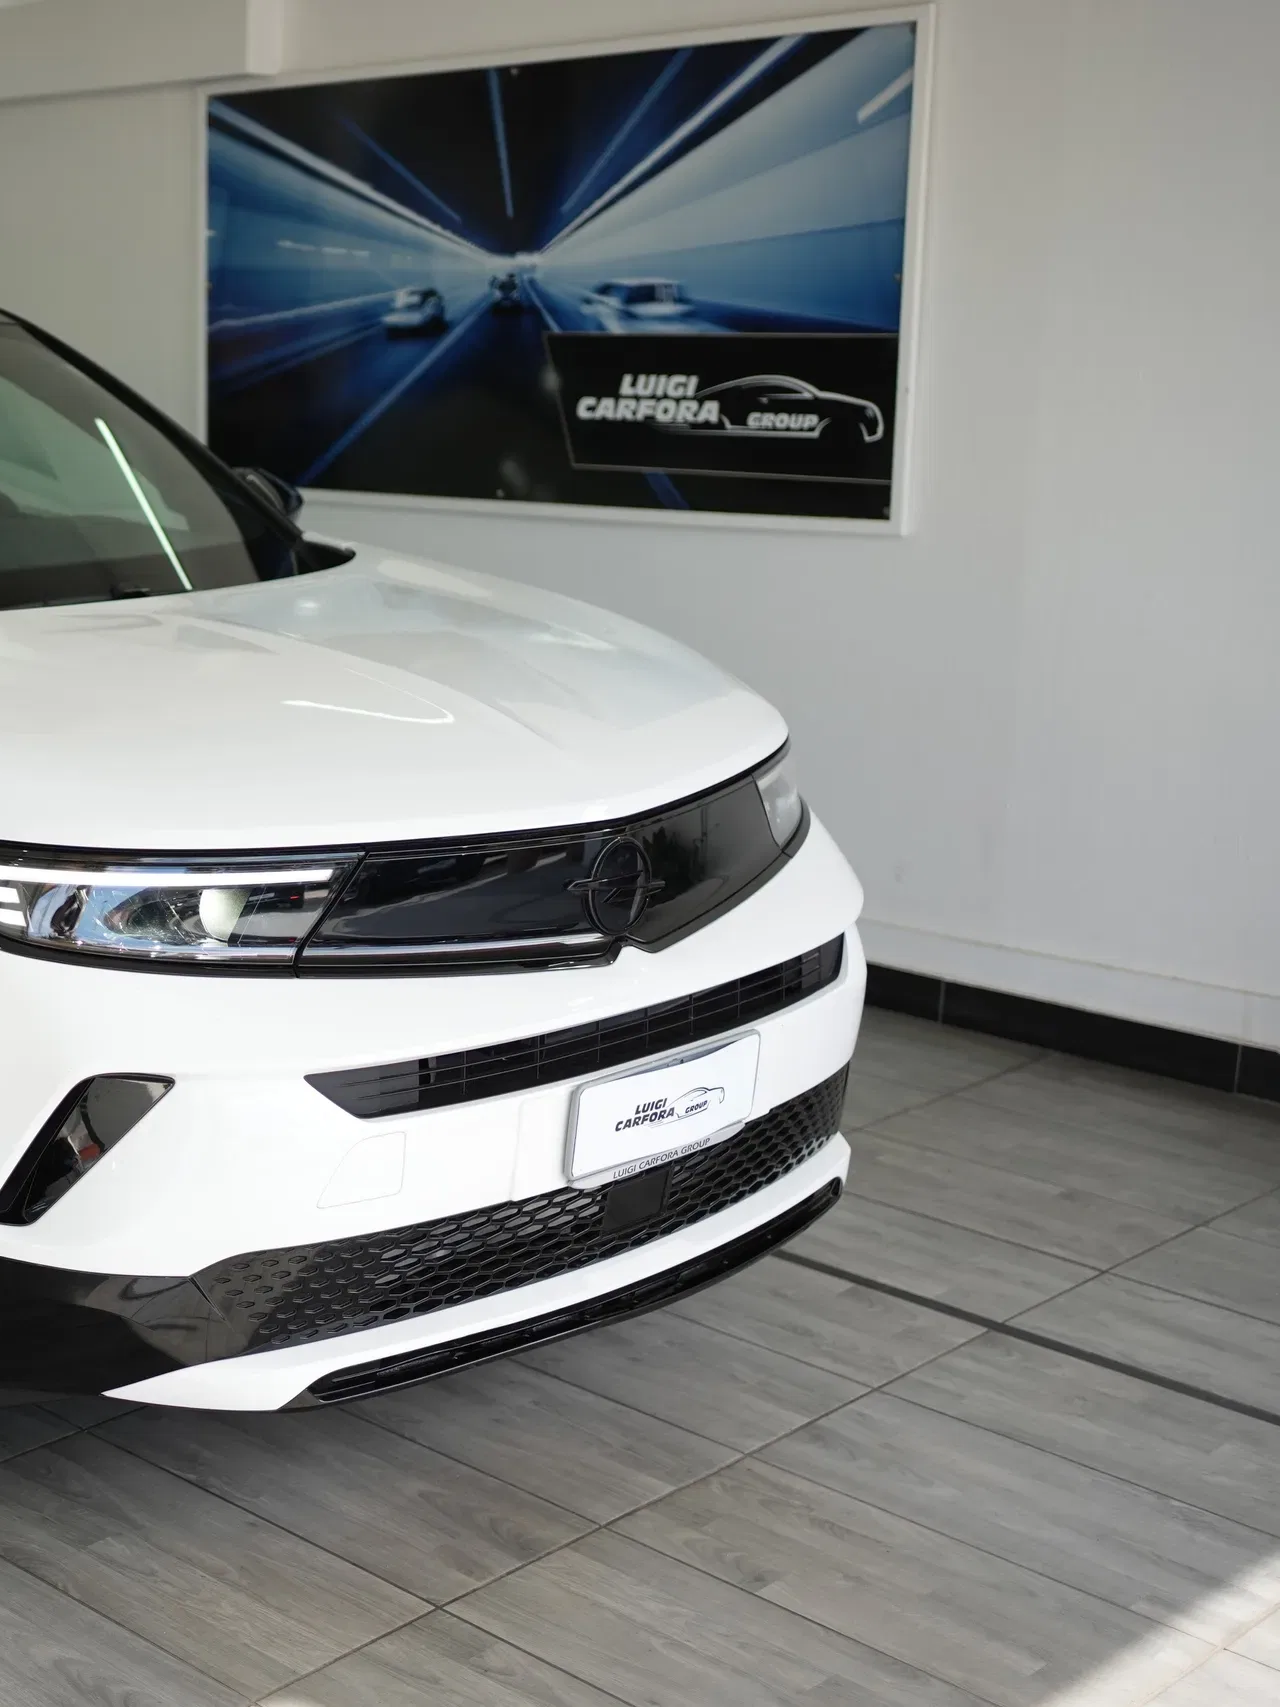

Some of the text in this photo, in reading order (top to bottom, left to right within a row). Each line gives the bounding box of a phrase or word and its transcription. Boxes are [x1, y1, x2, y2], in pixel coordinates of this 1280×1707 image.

[620, 373, 699, 398] LUIGI
[577, 397, 820, 430] CARFORA GROUP
[615, 1100, 708, 1132] CARFORA GROUP
[635, 1098, 668, 1115] LUIGI
[613, 1137, 711, 1179] LUIGI CARFORA GROUP
